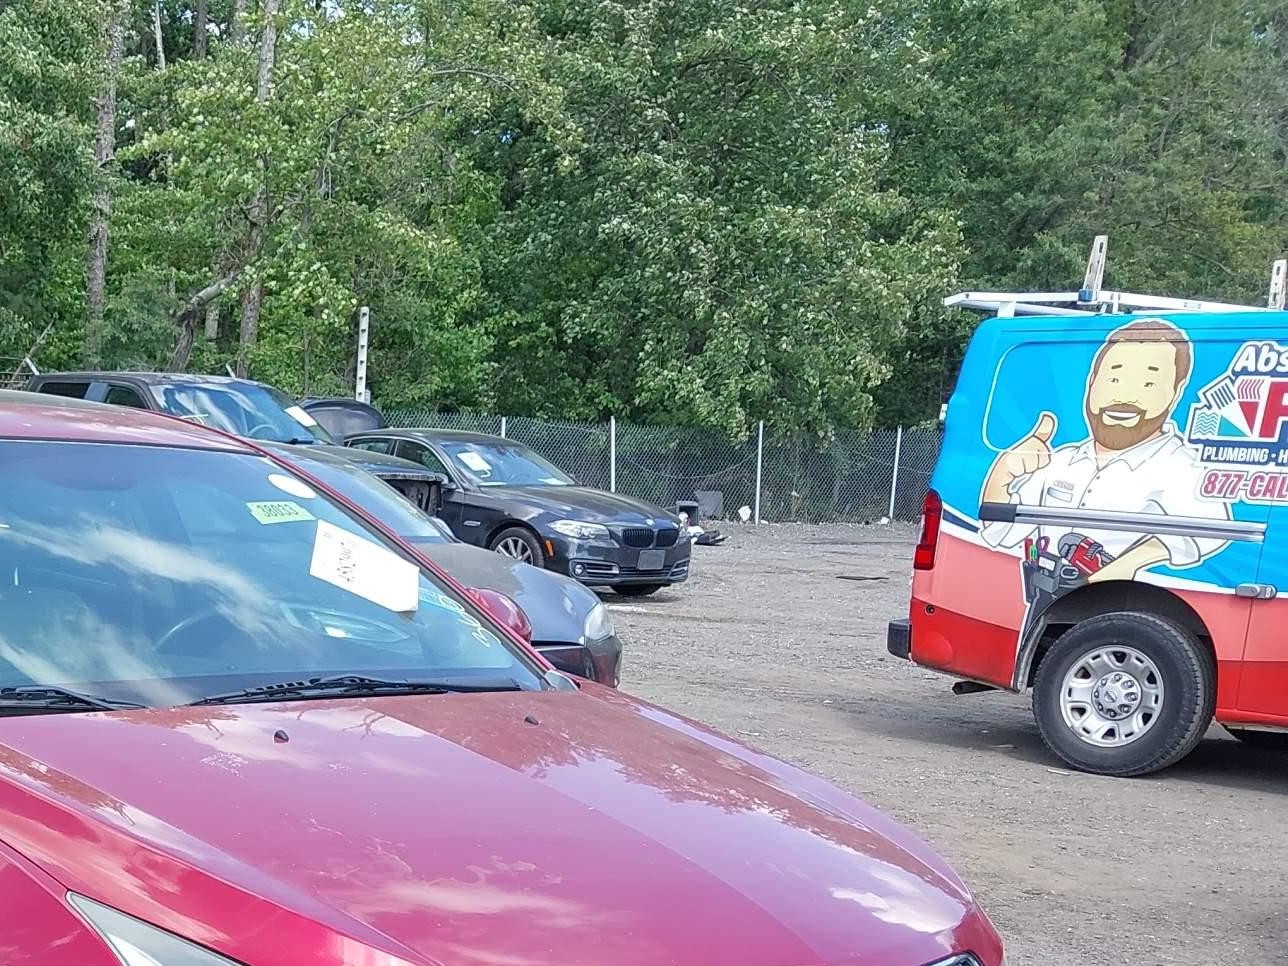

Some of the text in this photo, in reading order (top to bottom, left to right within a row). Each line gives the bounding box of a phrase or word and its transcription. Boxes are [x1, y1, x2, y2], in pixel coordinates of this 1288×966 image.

[1203, 446, 1269, 463] PLUMBING
[1203, 471, 1288, 499] 877-CAL
[256, 503, 299, 517] 38033
